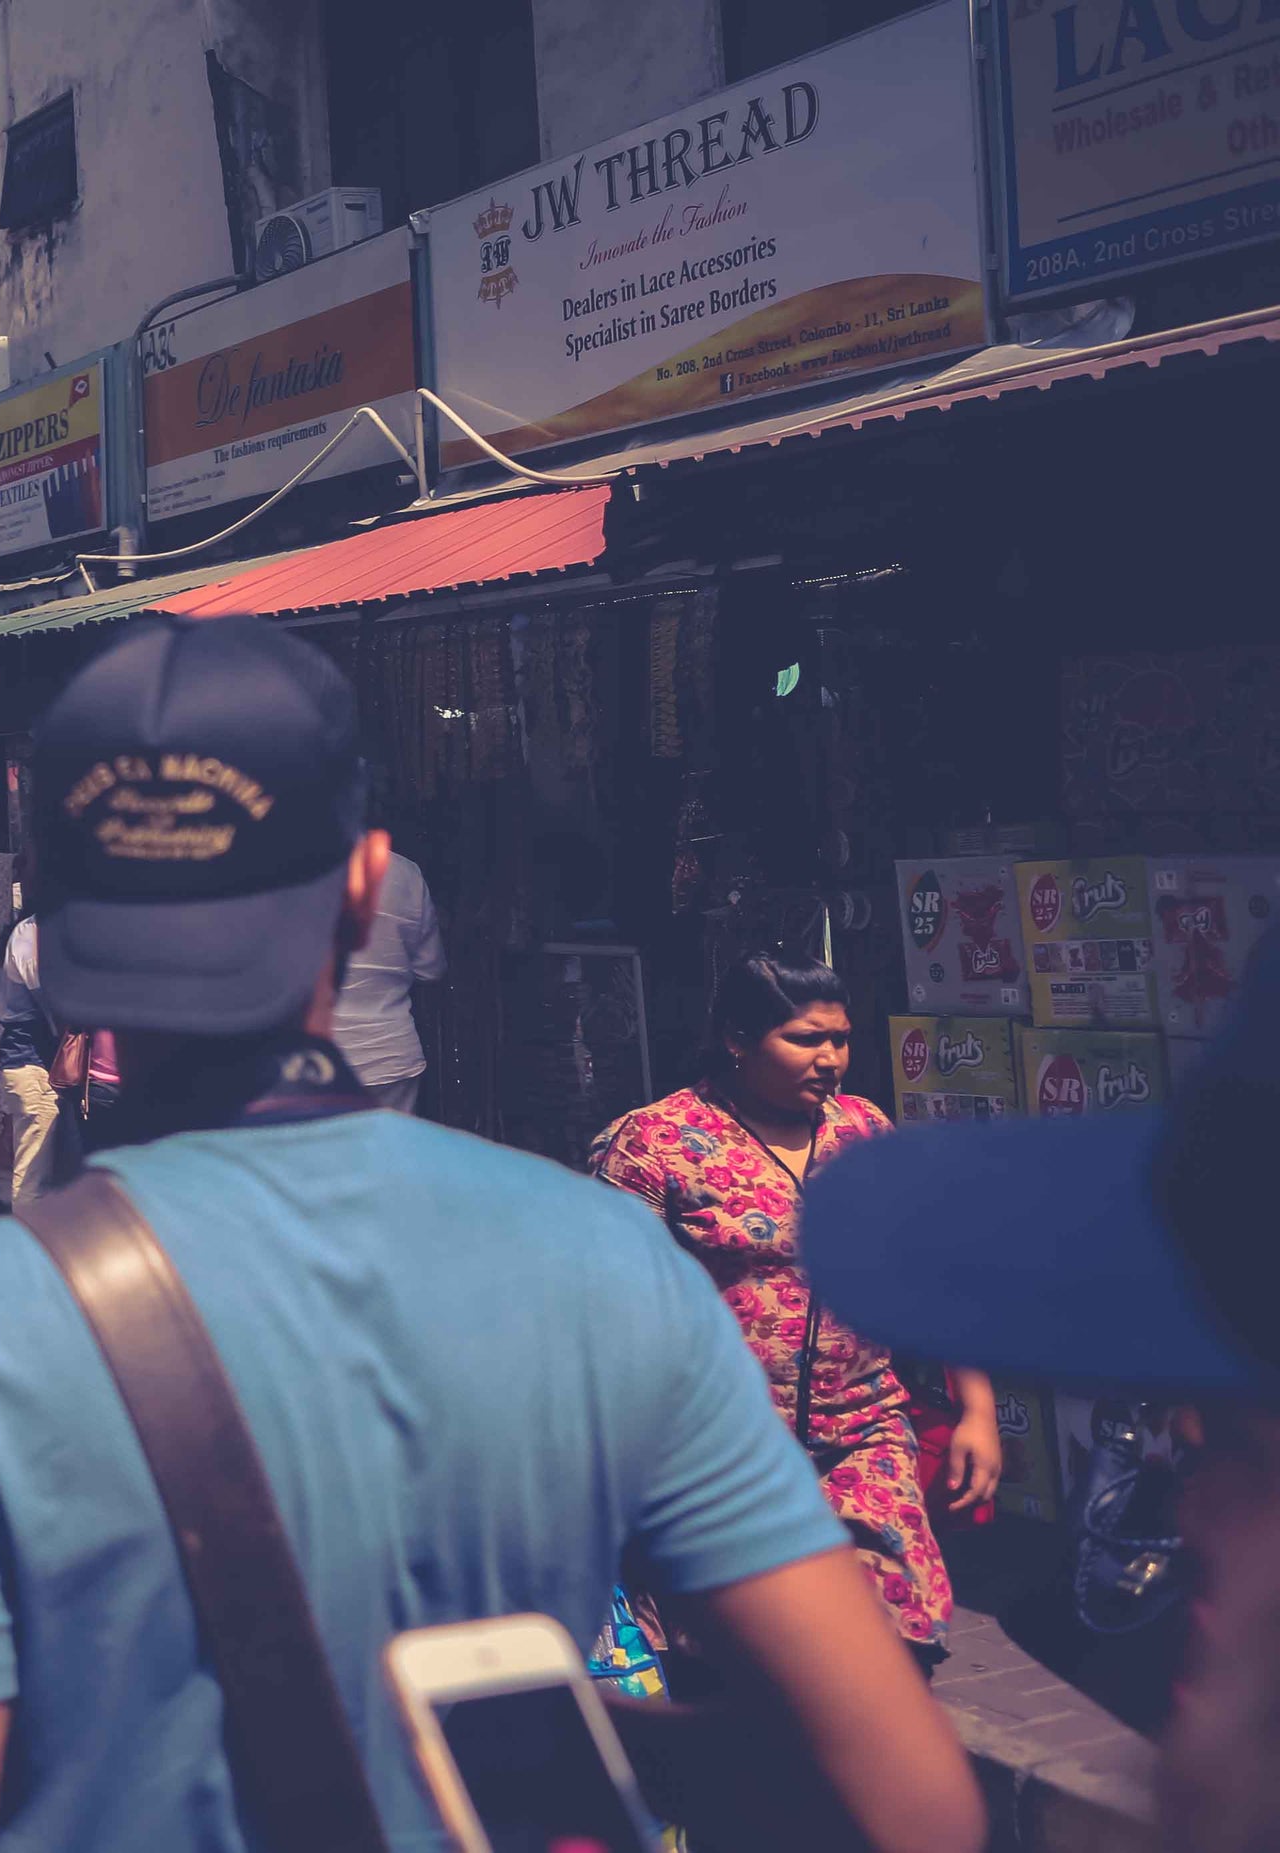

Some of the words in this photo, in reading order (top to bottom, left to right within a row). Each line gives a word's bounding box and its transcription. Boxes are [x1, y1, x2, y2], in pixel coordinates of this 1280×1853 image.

[1052, 0, 1280, 92] LA
[1052, 87, 1184, 155] Wholesale
[1197, 73, 1217, 111] &
[521, 154, 587, 244] JW
[594, 81, 820, 213] THREAD
[579, 234, 650, 271] Innovate
[651, 203, 674, 242] the
[679, 183, 748, 238] Fashion
[1094, 235, 1135, 264] 2nd
[1144, 219, 1214, 251] Cross
[562, 287, 618, 321] Dealers
[620, 278, 636, 303] in
[640, 269, 676, 298] Lace
[679, 235, 777, 286] Accessories
[565, 316, 637, 361] Specialist
[640, 310, 656, 335] in
[661, 298, 705, 328] Saree
[710, 276, 777, 315] Borders
[656, 367, 673, 382] No.
[676, 360, 699, 376] 208,
[702, 351, 723, 370] 2nd
[726, 345, 755, 366] Cross
[757, 334, 796, 358] Street,
[799, 321, 851, 345] Colombo
[863, 312, 884, 330] 11,
[887, 304, 906, 323] Sri
[909, 294, 950, 317] Lanka
[143, 323, 177, 374] ABC
[194, 352, 240, 428] De
[738, 363, 791, 387] Facebook
[214, 449, 229, 464] The
[231, 439, 265, 460] fashions
[267, 420, 327, 452] requirements
[911, 891, 940, 914] SR
[1032, 887, 1058, 906] SR
[1033, 906, 1054, 922] 25
[914, 916, 935, 935] 25
[903, 1041, 926, 1057] SR
[905, 1057, 923, 1072] 25
[1042, 1077, 1082, 1103] SR
[996, 1392, 1030, 1436] uts
